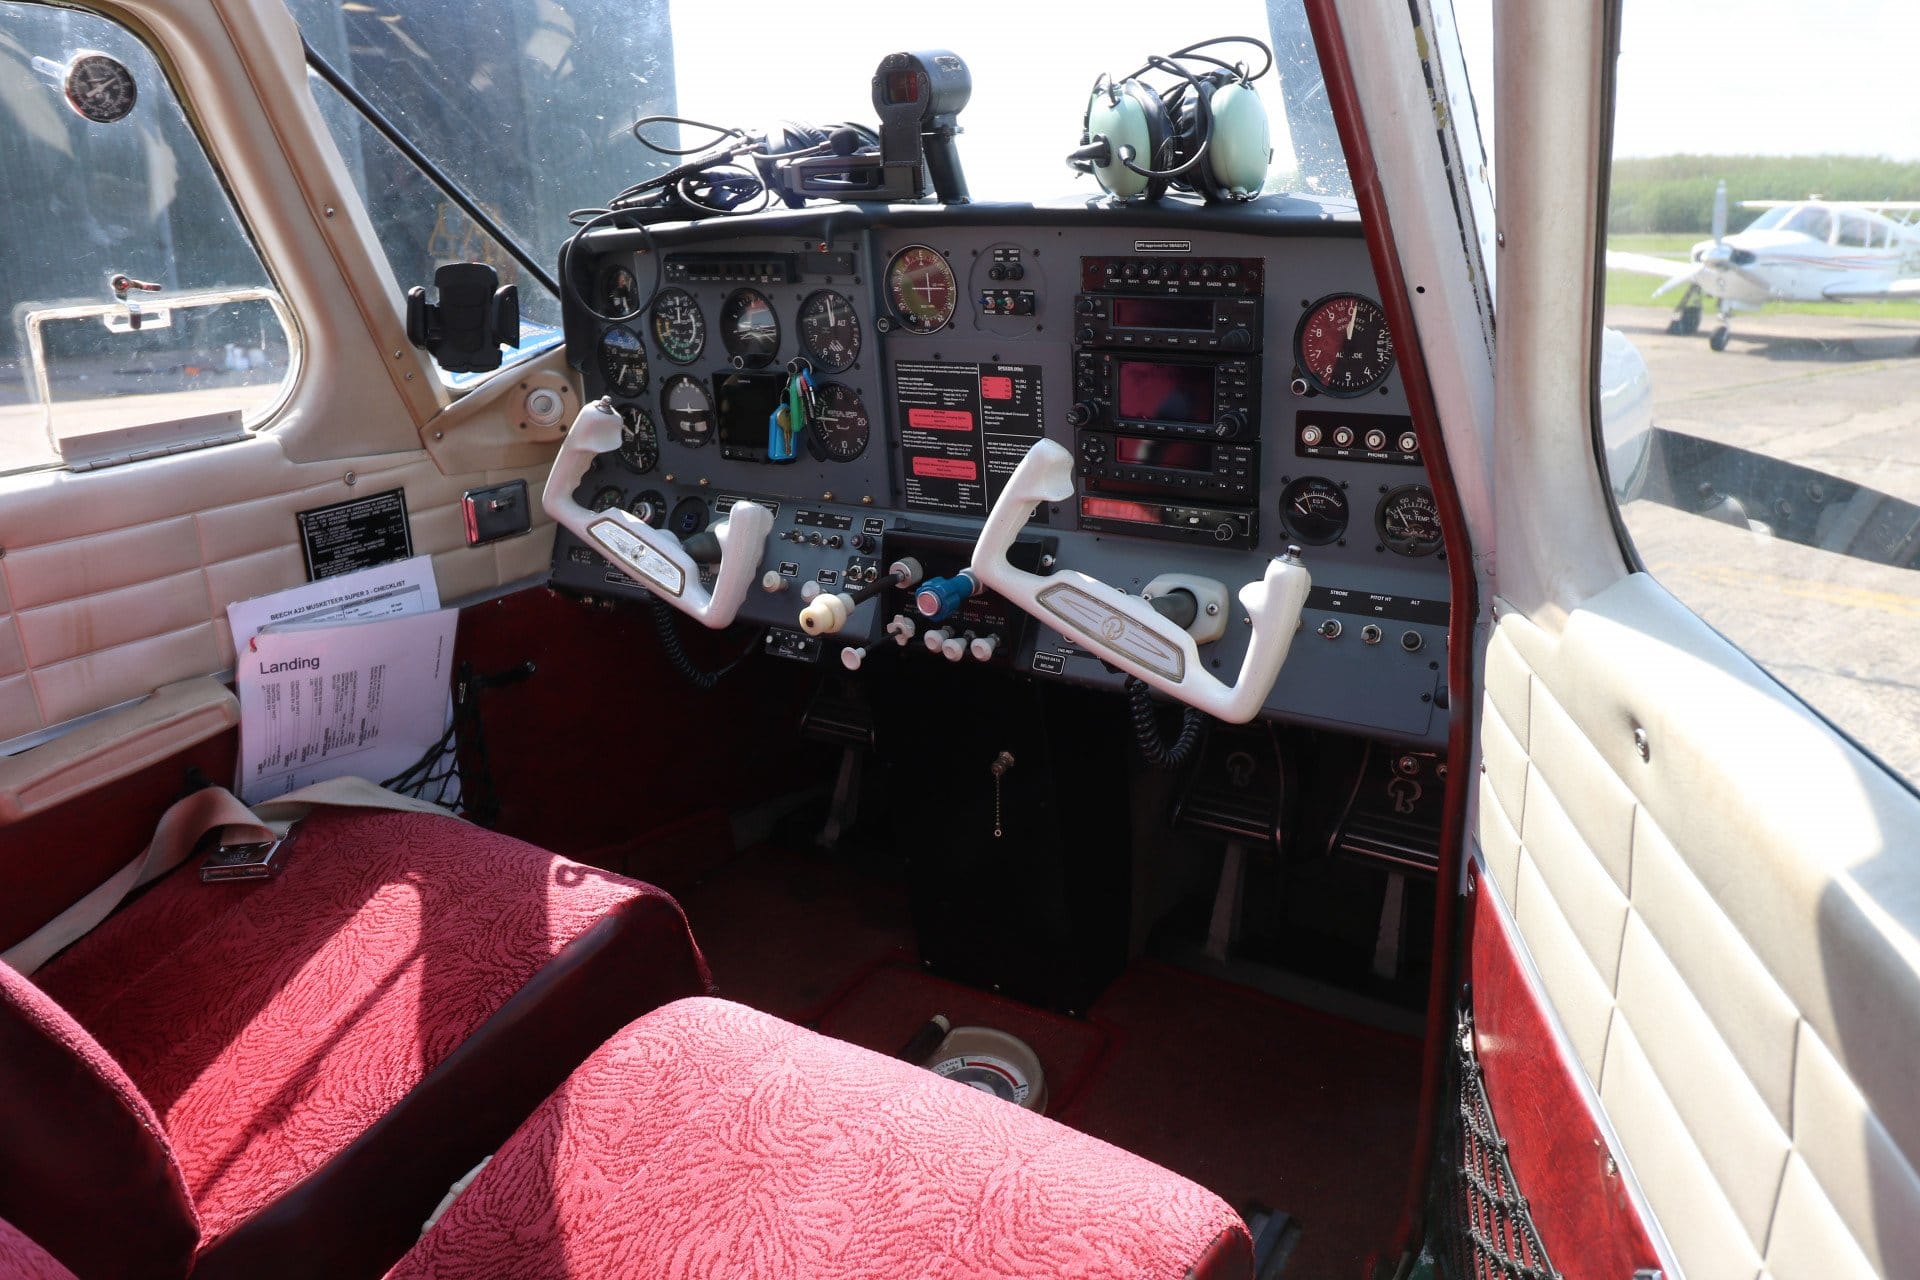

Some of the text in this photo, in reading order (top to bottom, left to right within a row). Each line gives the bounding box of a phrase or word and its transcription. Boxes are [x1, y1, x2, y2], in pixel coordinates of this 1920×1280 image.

[1328, 312, 1335, 321] 9
[1316, 329, 1322, 337] 8
[1379, 330, 1385, 338] 2
[1345, 372, 1351, 380] 5
[270, 610, 293, 620] BEECH
[306, 596, 344, 612] MUSKETEER
[344, 591, 365, 601] SUPER
[373, 580, 405, 593] CHECKLIST
[260, 656, 320, 675] Landing
